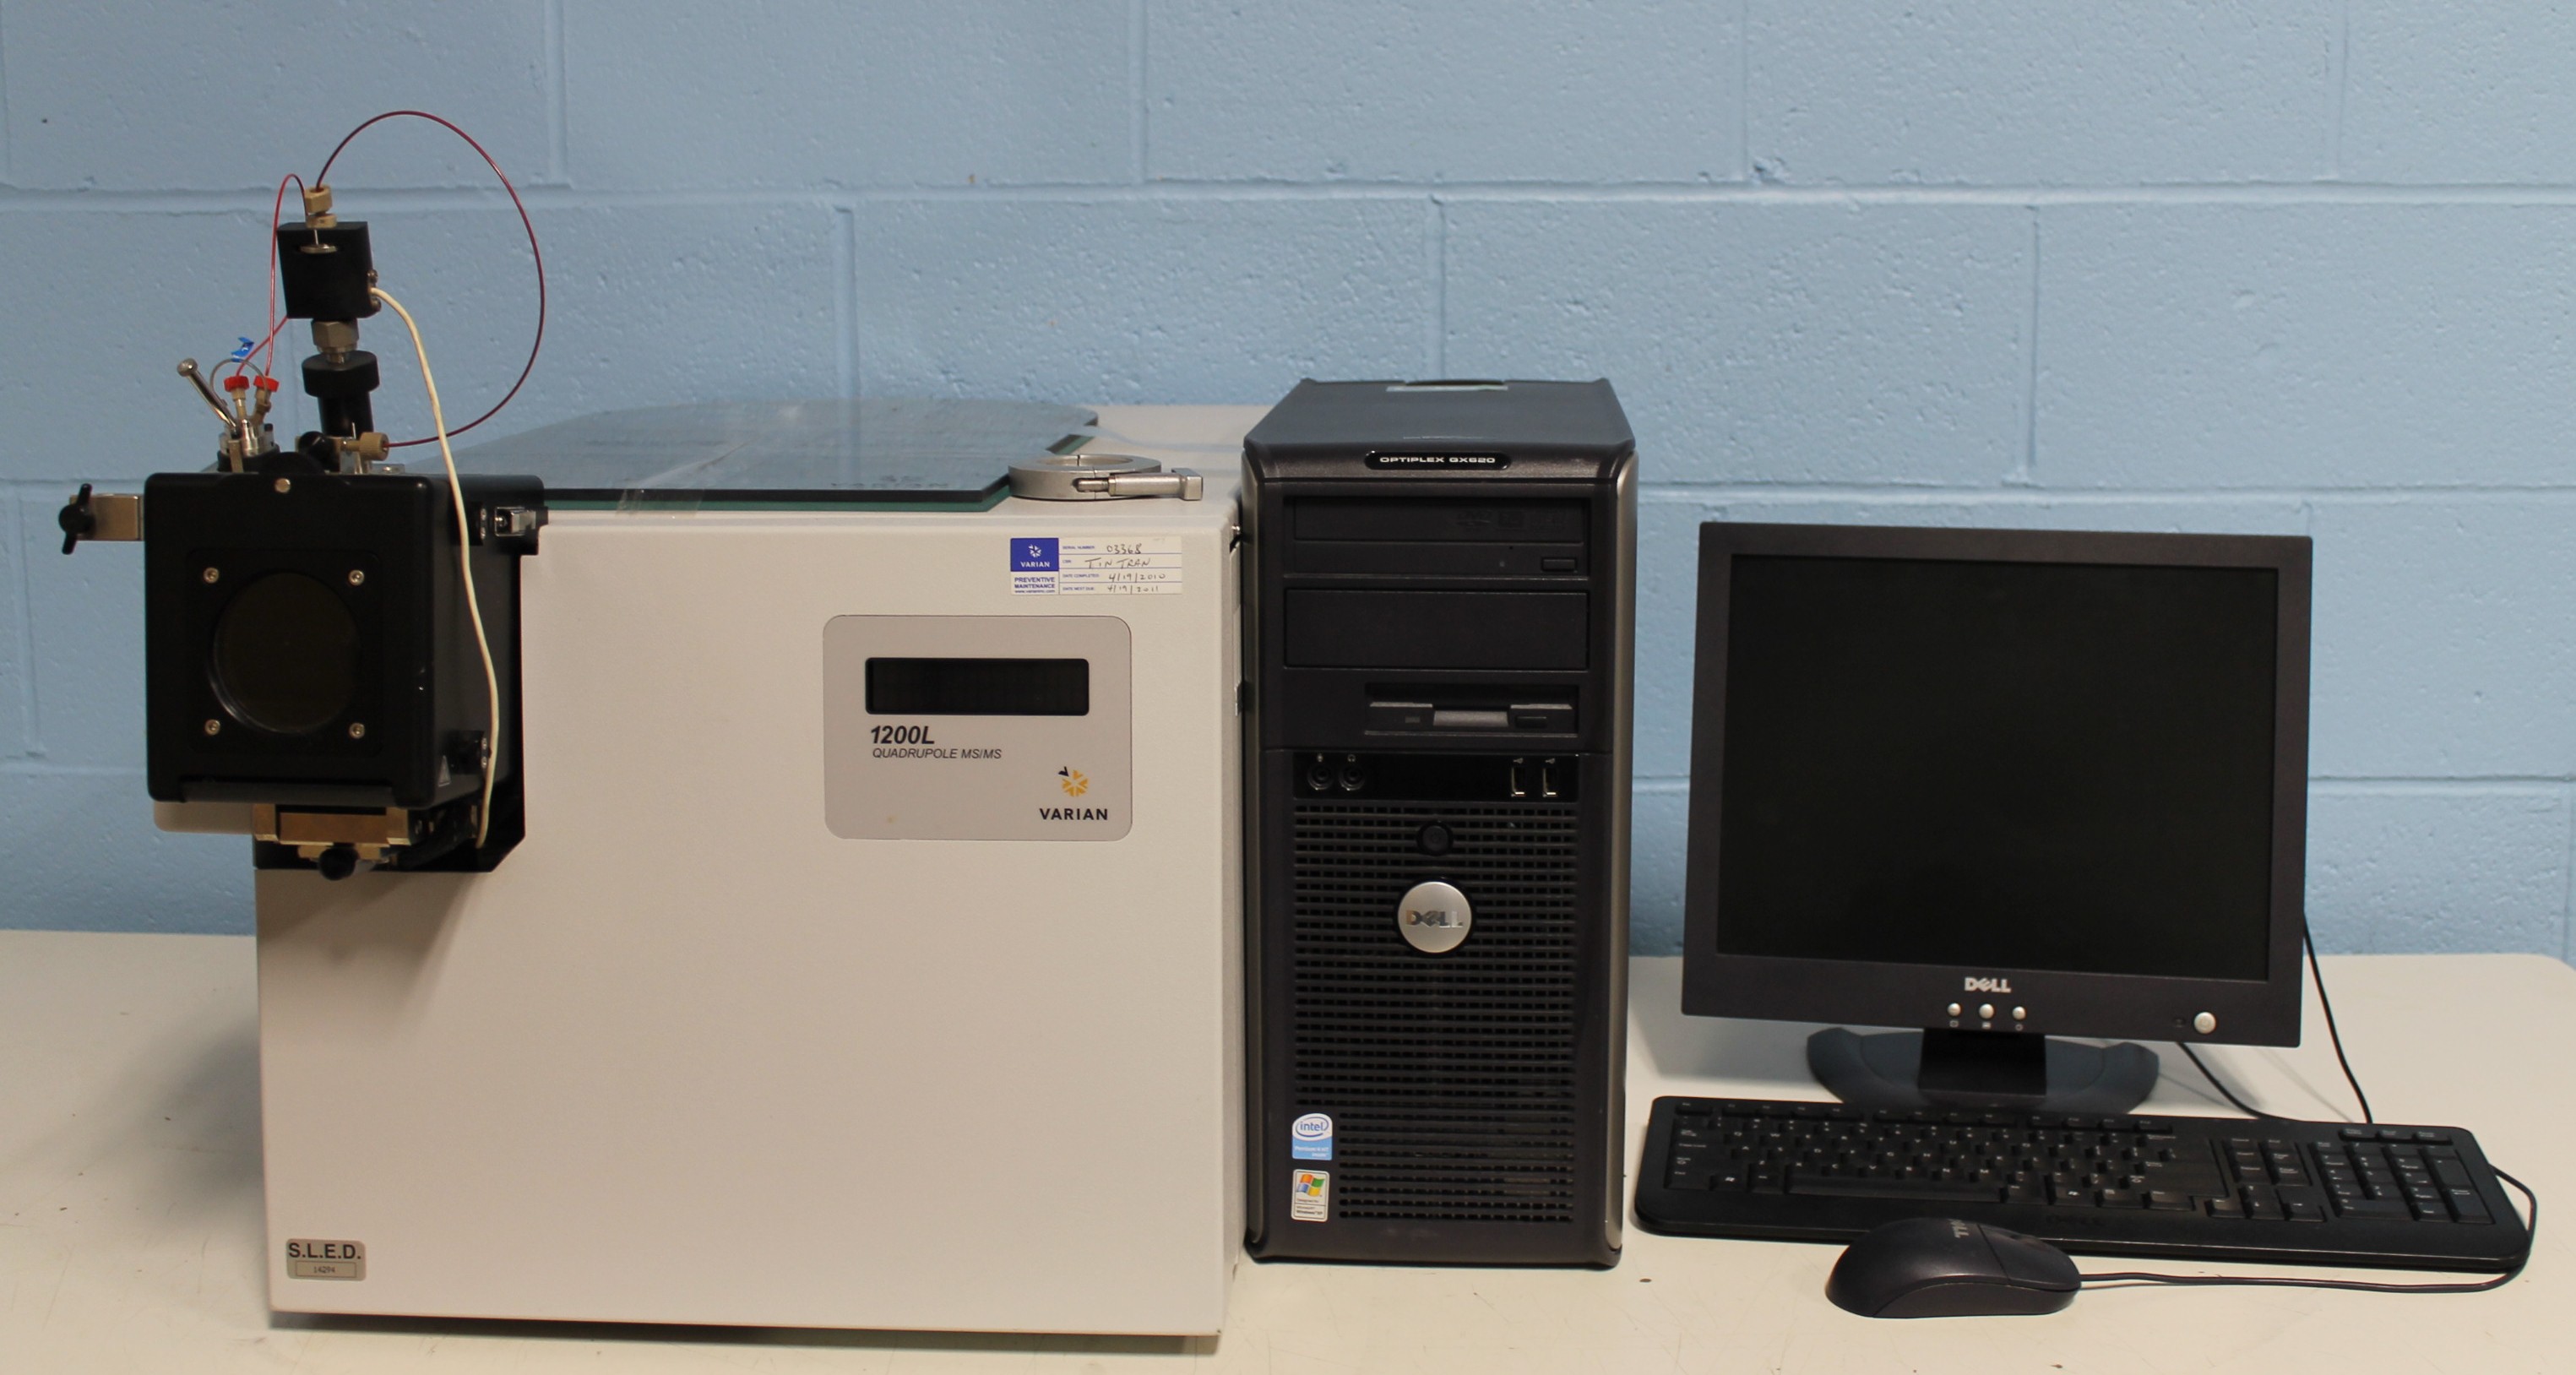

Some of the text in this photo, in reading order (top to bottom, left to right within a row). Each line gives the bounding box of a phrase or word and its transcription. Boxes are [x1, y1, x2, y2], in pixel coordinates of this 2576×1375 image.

[1106, 543, 1142, 554] 03368
[870, 726, 935, 744] 1200L
[872, 747, 1002, 759] QUADRUPOLE MS/MS
[1039, 808, 1108, 821] VARIAN
[1405, 910, 1464, 927] DELL
[1964, 976, 2012, 993] DELL
[1300, 1122, 1324, 1131] intel
[289, 1242, 361, 1259] S.L.E.D.
